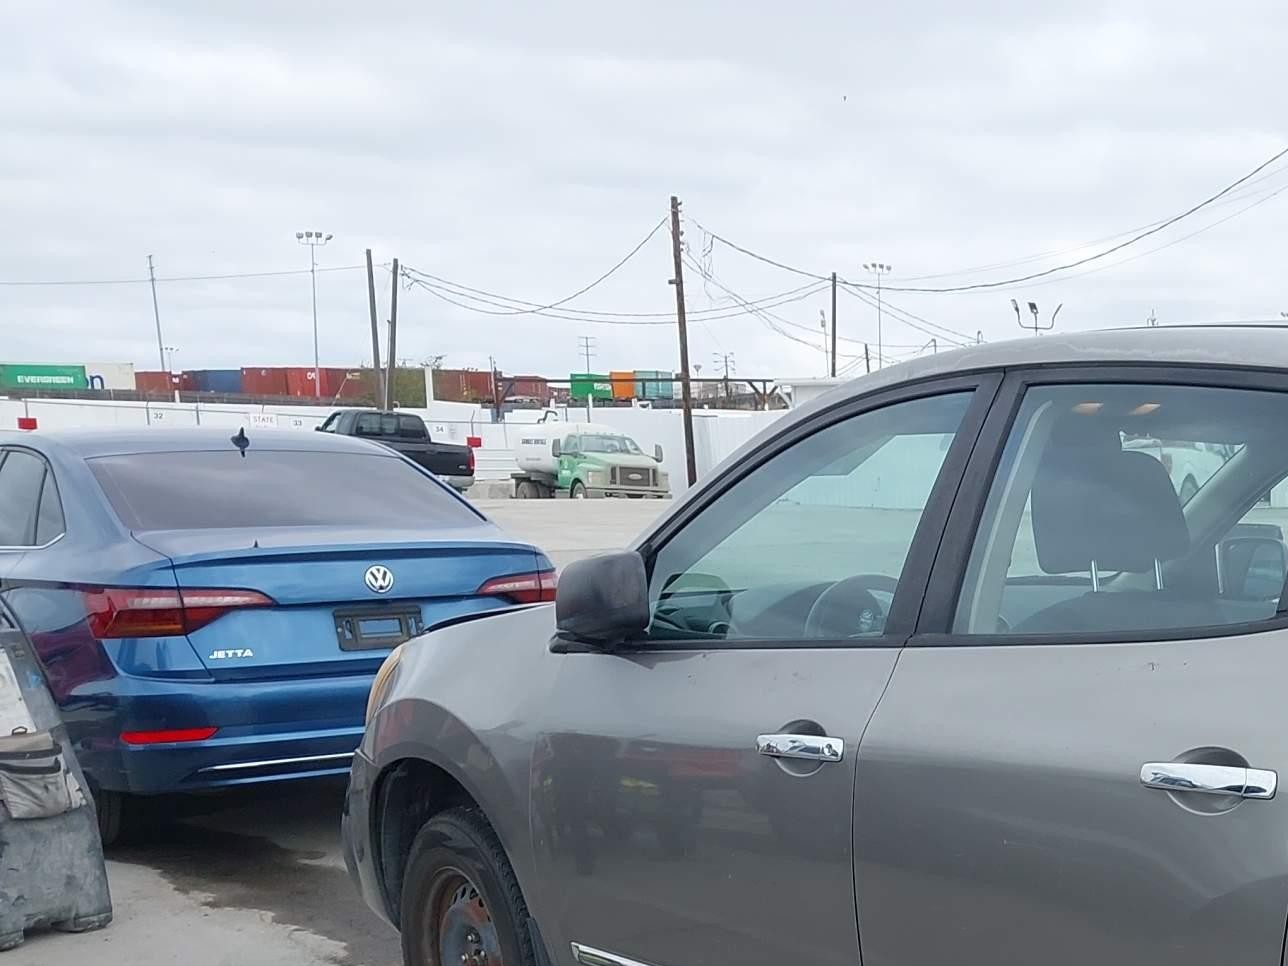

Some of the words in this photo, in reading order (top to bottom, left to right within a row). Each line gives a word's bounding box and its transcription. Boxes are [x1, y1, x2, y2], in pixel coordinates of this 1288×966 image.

[17, 375, 74, 385] EVERGREEN
[253, 416, 275, 424] STATE
[209, 648, 254, 659] JETTA
